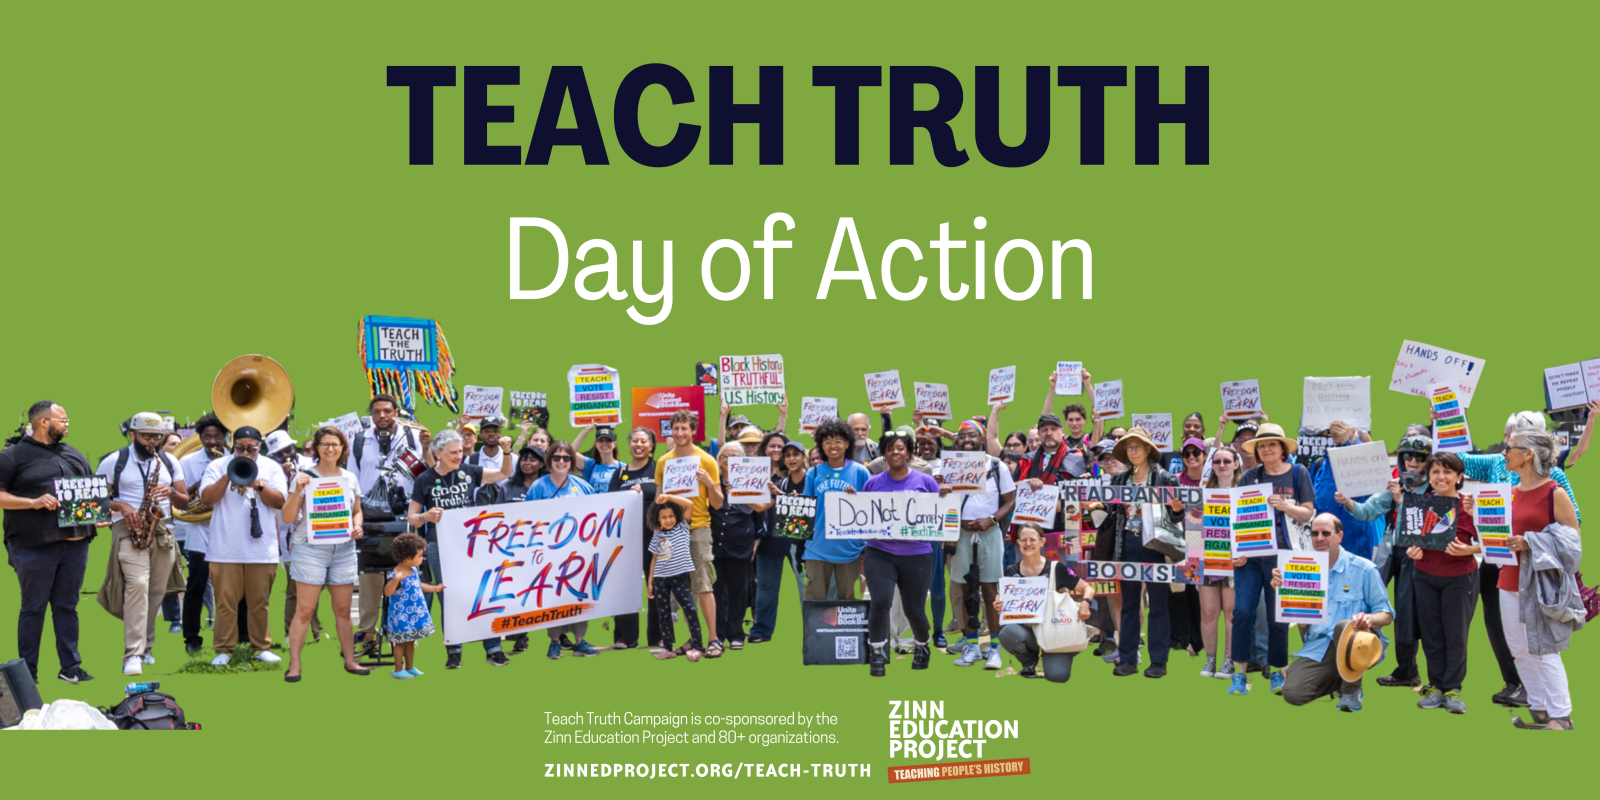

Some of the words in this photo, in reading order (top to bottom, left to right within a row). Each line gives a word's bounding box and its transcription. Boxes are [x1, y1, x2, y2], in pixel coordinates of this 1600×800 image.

[381, 328, 419, 340] TEACH
[388, 340, 409, 349] THE
[380, 348, 423, 361] TRUTH
[1405, 344, 1439, 361] HANDS
[1444, 355, 1474, 376] OFF!
[721, 357, 750, 373] Black
[752, 357, 782, 374] History
[723, 375, 730, 384] is
[731, 372, 782, 386] TRUTHFUL
[582, 384, 604, 392] VOTE
[870, 387, 900, 401] LEARN
[510, 391, 546, 399] FREEDOM
[580, 392, 609, 401] RESIST
[724, 391, 744, 404] U.S.
[746, 391, 784, 404] History
[1435, 394, 1453, 403] TEACH
[465, 403, 499, 415] LEARN
[511, 399, 522, 407] TO
[523, 399, 547, 408] READ
[573, 401, 617, 410] ORGANIZE
[918, 399, 949, 411] LEARN
[1096, 397, 1121, 410] LEARN
[1225, 397, 1259, 410] LEARN
[1438, 401, 1453, 410] VOTE
[1439, 410, 1457, 418] RESIST
[1438, 416, 1464, 426] ORGANIZE
[1297, 436, 1335, 446] FREEDO
[1311, 446, 1326, 456] RE
[943, 457, 984, 470] FREEDOM
[1337, 456, 1368, 467] HANDS
[1371, 454, 1387, 463] OFF
[665, 463, 698, 474] FREEDOM
[730, 463, 769, 474] FREEDOM
[1341, 467, 1388, 479] LIBRARIES
[54, 477, 107, 490] FREEDOM
[664, 475, 698, 489] LEARN
[730, 477, 769, 490] LEARN
[943, 471, 985, 484] LEARN
[817, 481, 829, 493] THE
[830, 479, 848, 489] FUTU
[1344, 478, 1387, 490] MUSEUMS
[56, 489, 72, 501] TO
[74, 488, 108, 501] READ
[1018, 487, 1056, 502] FREEDOM
[1065, 486, 1116, 502] READ
[1121, 487, 1203, 504] BANNED
[776, 495, 817, 507] FREEDOM
[1241, 497, 1262, 505] TEACH
[311, 511, 348, 519] ORGANIZE
[775, 505, 788, 515] TO
[789, 505, 816, 518] READ
[838, 498, 868, 526] Do
[871, 498, 900, 525] Not
[1015, 502, 1054, 517] LEARN
[1208, 506, 1230, 514] TEA
[1210, 517, 1230, 526] VOT
[1240, 513, 1264, 521] RESIST
[1234, 520, 1270, 529] ORGANIZE
[463, 508, 625, 558] FREEDOM
[1206, 529, 1230, 539] RESI
[531, 549, 544, 564] TO
[1087, 562, 1176, 582] BOOKS!
[1290, 564, 1316, 572] TEACH
[467, 545, 624, 621] LEARN
[1288, 581, 1317, 589] RESIST
[1004, 583, 1046, 597] FREEDOM
[1002, 599, 1045, 613] LEARN
[501, 605, 582, 629] #TeachTruth
